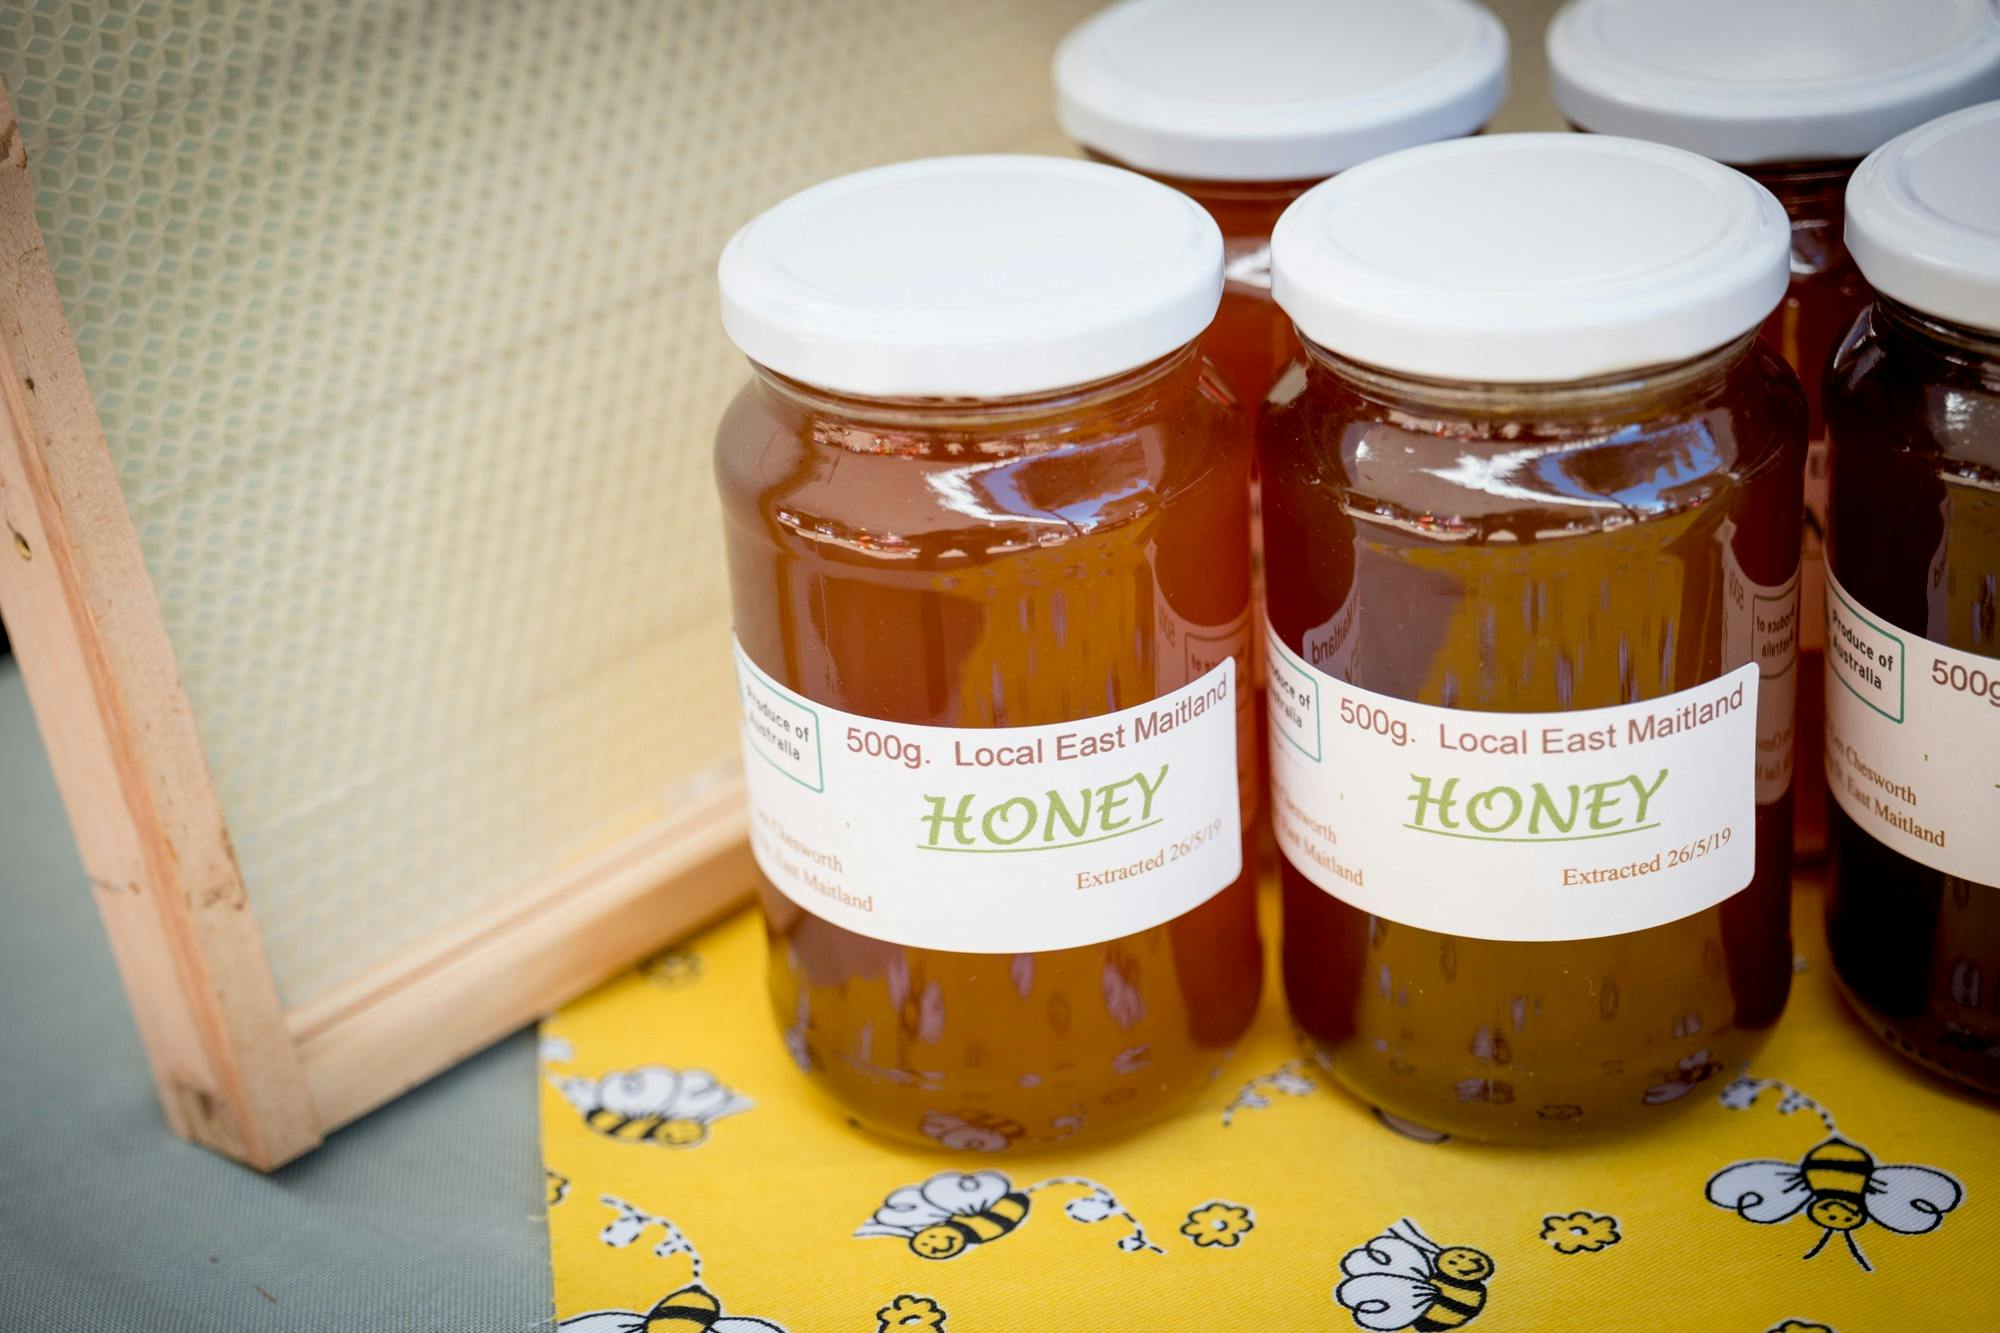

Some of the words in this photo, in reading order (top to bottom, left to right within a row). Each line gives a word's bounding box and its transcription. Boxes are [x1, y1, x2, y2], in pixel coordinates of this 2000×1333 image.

[1832, 608, 1875, 660] Produce
[1878, 655, 1894, 672] of
[1833, 633, 1883, 691] Australia
[795, 725, 810, 743] of
[846, 726, 931, 769] 500g.
[954, 737, 1044, 767] Local
[1056, 723, 1126, 762] East
[1134, 672, 1227, 744] Maitland
[1298, 693, 1311, 711] of
[1340, 697, 1416, 746] 500g.
[1439, 723, 1527, 754] Local
[1541, 719, 1617, 754] East
[1628, 681, 1743, 745] Maitland
[921, 764, 1169, 847] HONEY
[1407, 768, 1669, 835] HONEY
[1846, 745, 1917, 806] Chesworth
[1847, 774, 1871, 810] East
[1874, 797, 1945, 848] Maitland
[1076, 849, 1165, 890] Extracted
[1170, 817, 1222, 862] 26/5/19
[1562, 854, 1662, 887] Extracted
[1667, 826, 1732, 868] 26/5/19
